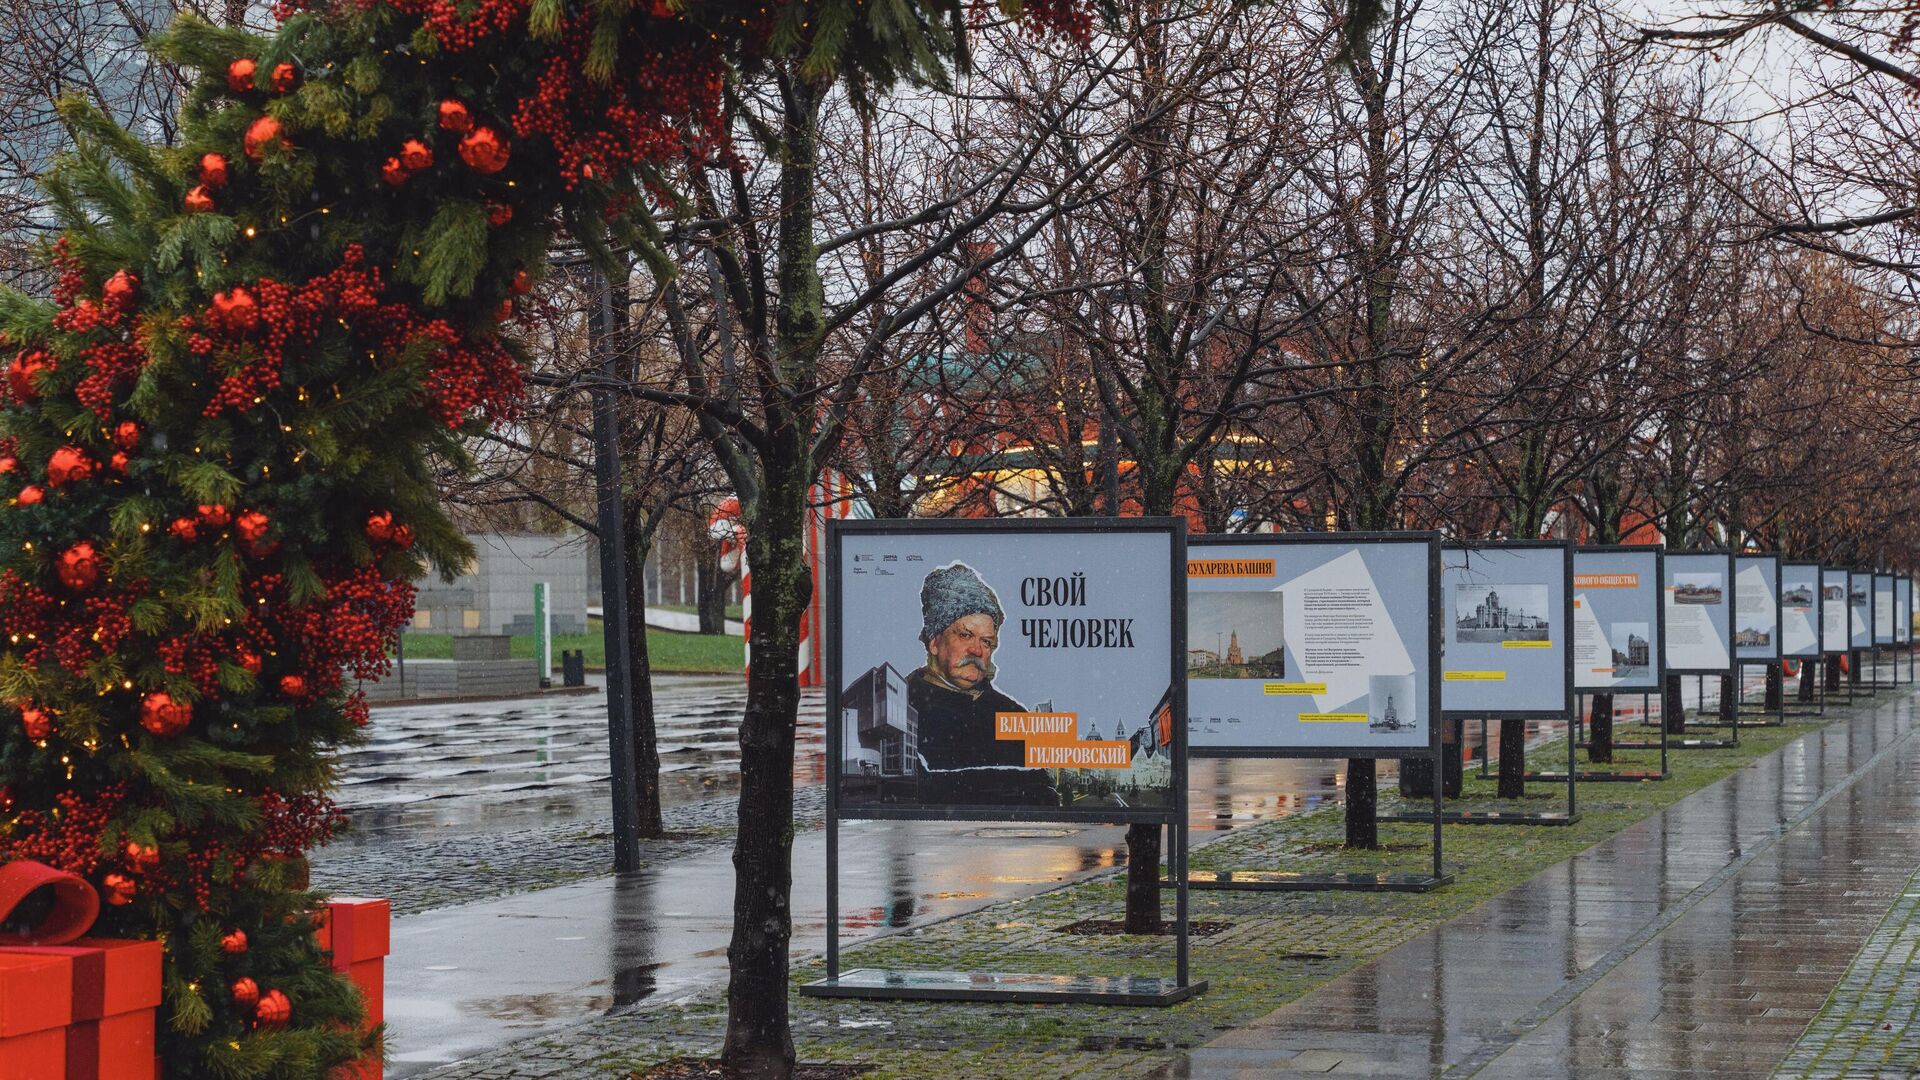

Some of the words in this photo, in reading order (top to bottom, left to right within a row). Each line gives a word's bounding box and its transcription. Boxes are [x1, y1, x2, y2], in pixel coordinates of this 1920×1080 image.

[1187, 562, 1235, 575] СУХАРЕВА
[1236, 562, 1272, 575] БАШНЯ
[1021, 572, 1086, 607] СВОЙ
[1599, 576, 1636, 586] ОБЩЕСТВА
[1021, 618, 1134, 648] ЧЕЛОВЕК
[1000, 716, 1073, 735] ВЛАДИМИР
[1029, 744, 1126, 765] ГИЛЯРОВСКИЙ
